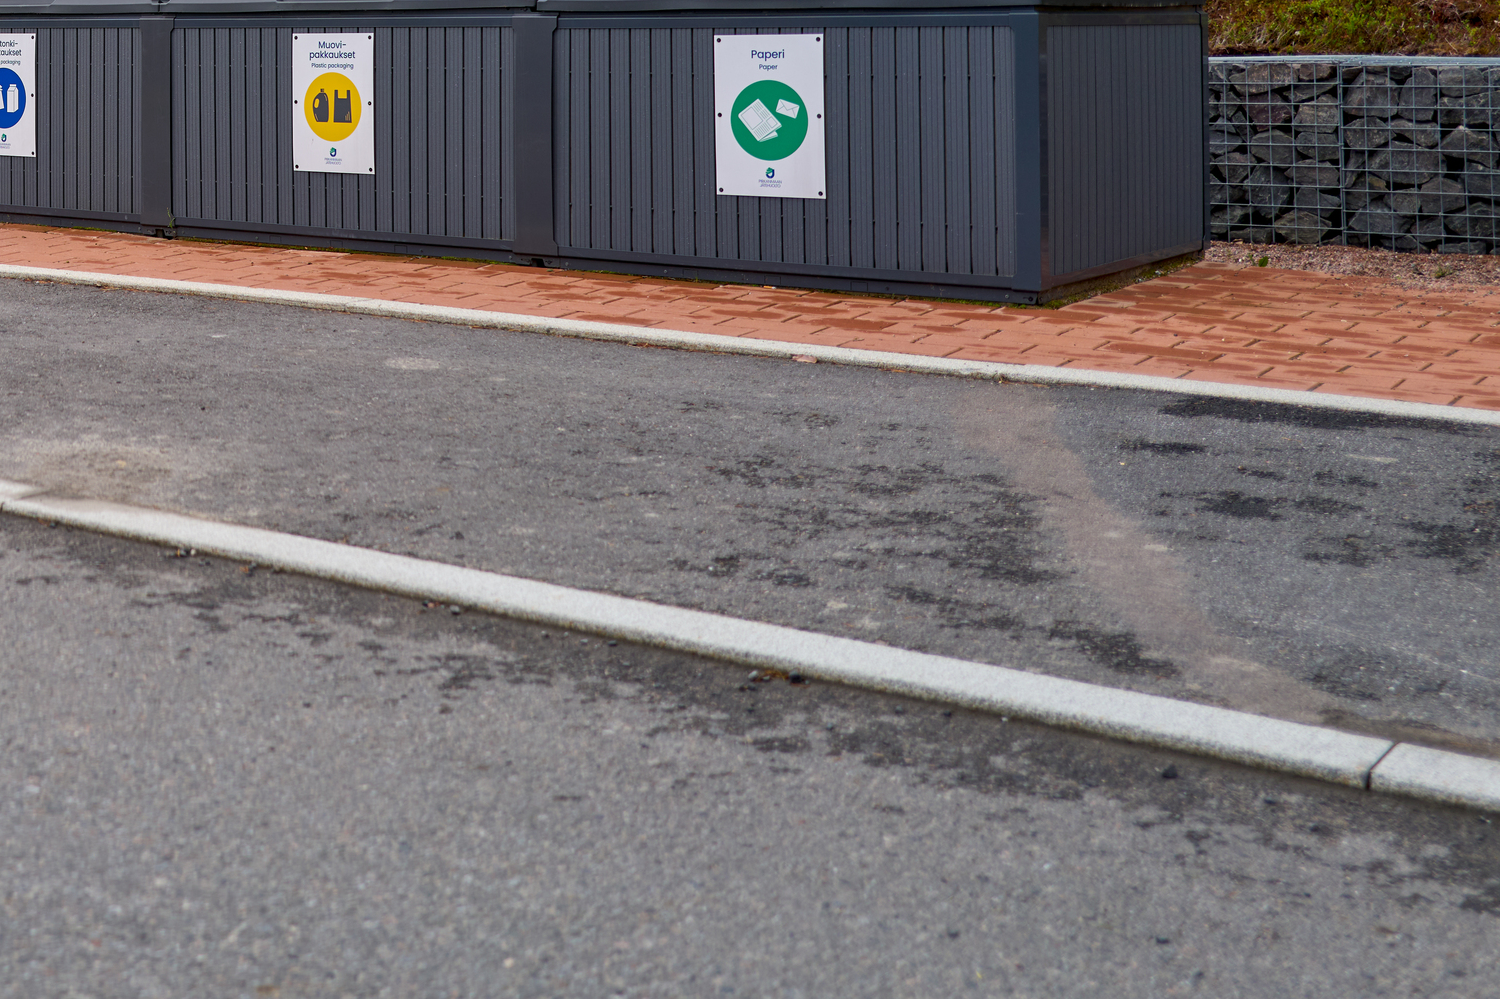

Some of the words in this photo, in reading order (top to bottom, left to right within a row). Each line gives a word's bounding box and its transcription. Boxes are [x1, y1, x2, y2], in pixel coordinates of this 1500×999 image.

[318, 40, 347, 49] Muovi-
[309, 50, 356, 61] pakkaukset
[750, 49, 785, 61] Paperi
[327, 62, 354, 70] packaging
[758, 63, 778, 71] Paper
